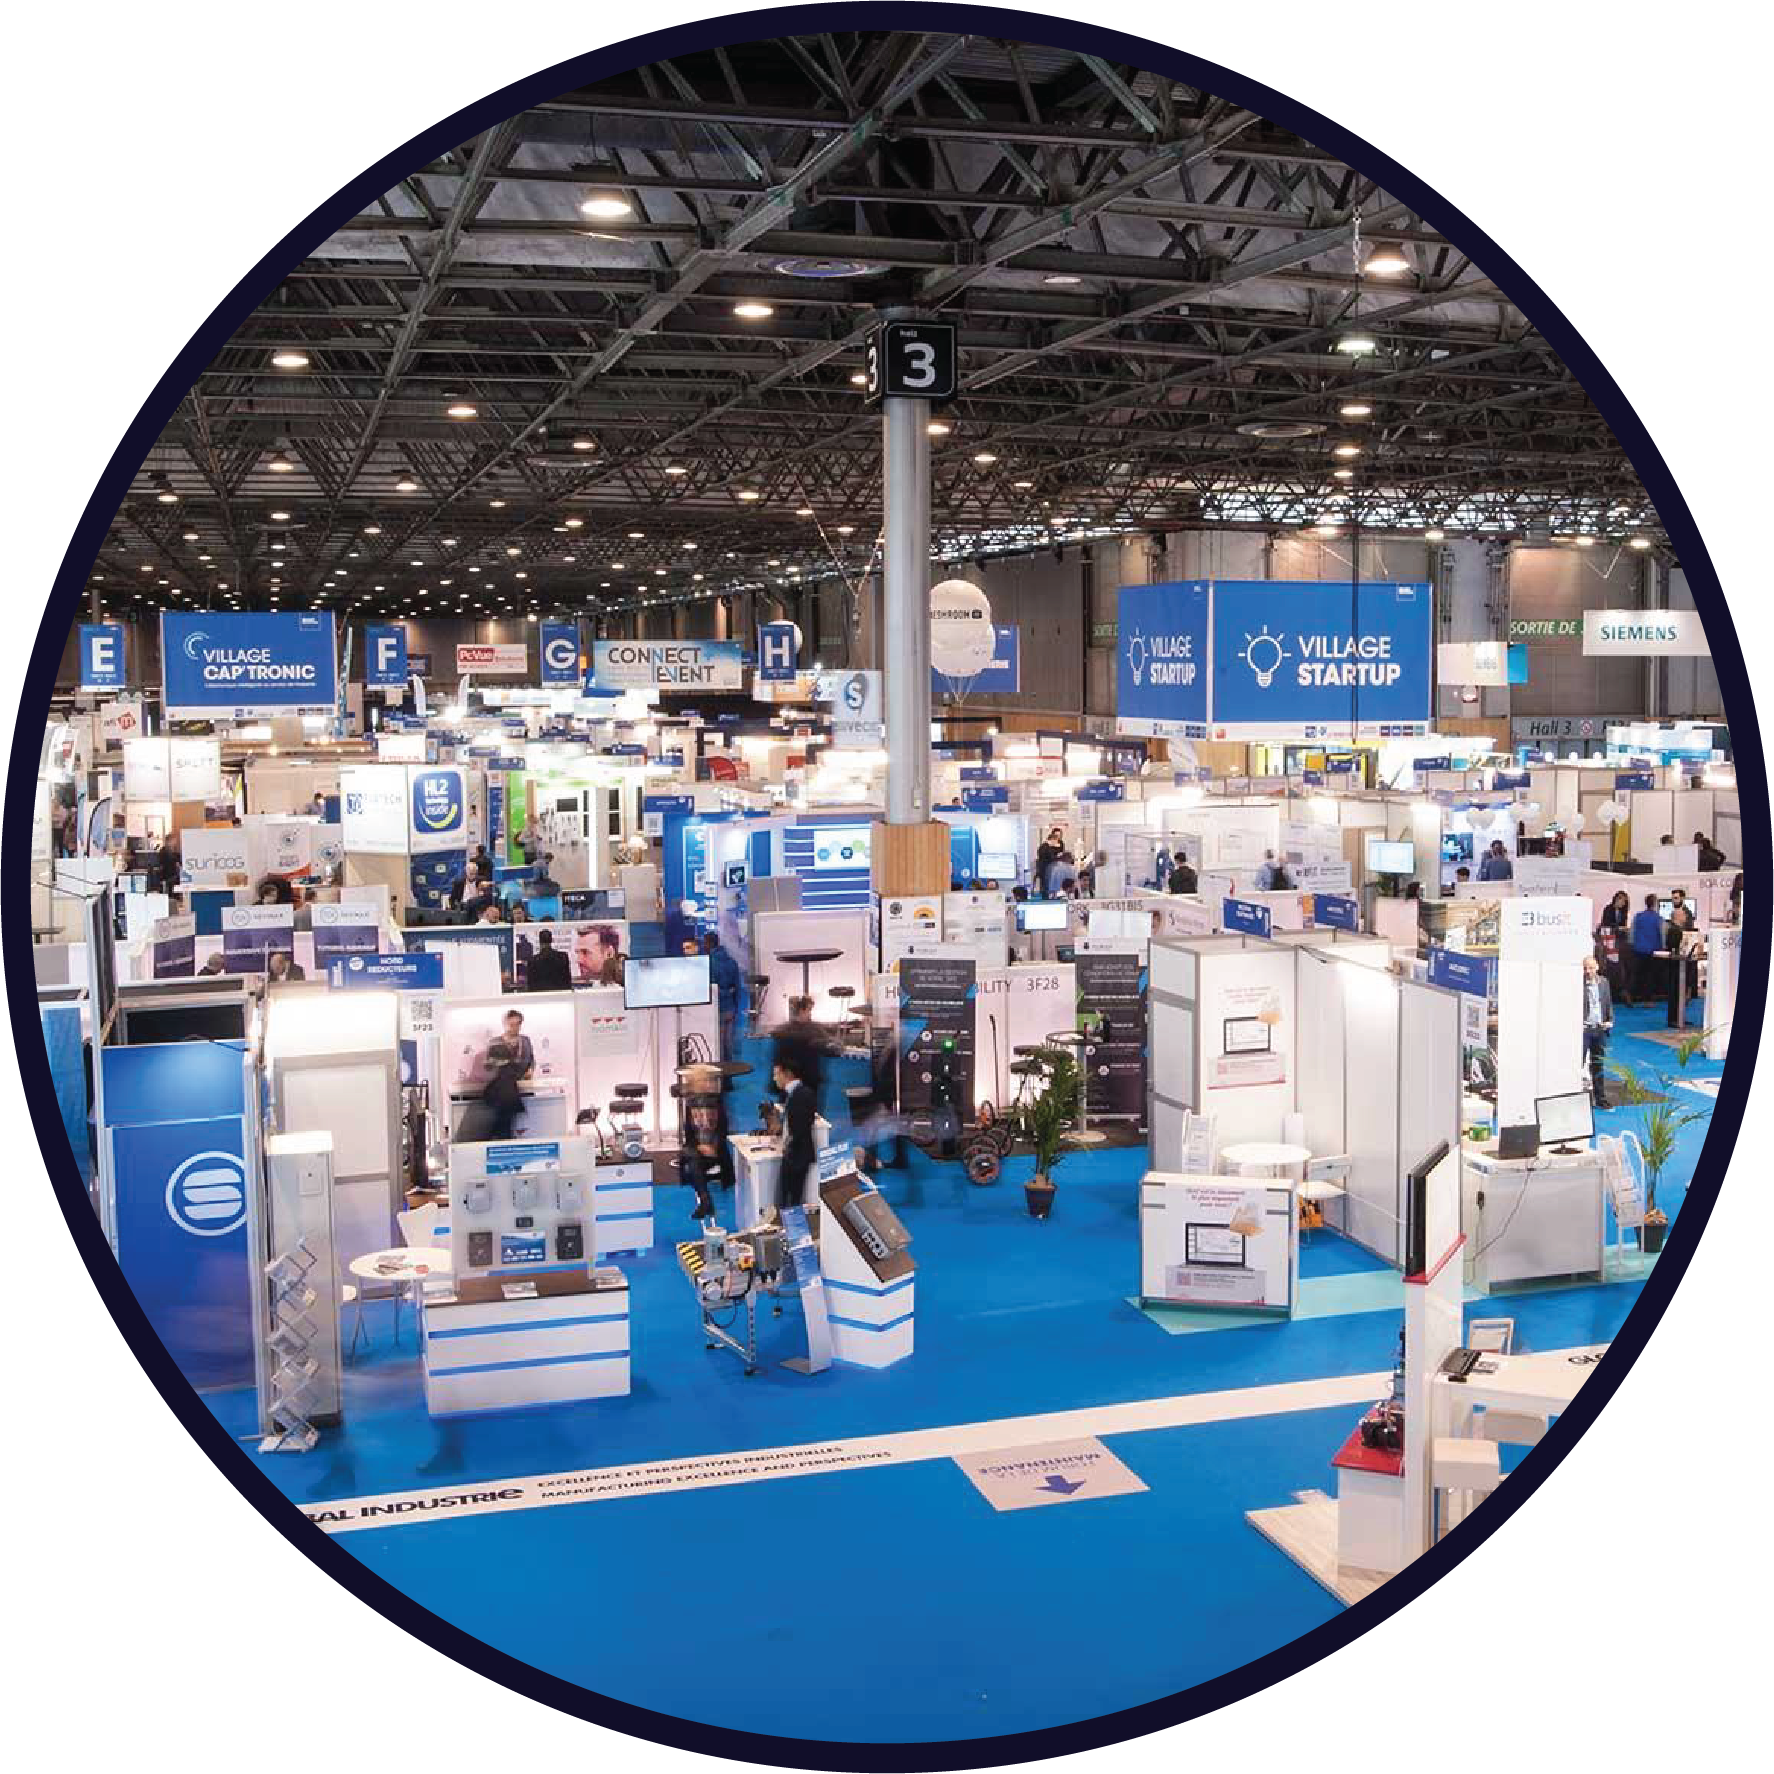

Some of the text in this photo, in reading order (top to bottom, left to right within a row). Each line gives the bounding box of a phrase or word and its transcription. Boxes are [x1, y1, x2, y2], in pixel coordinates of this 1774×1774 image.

[868, 346, 879, 391] 3
[903, 343, 935, 387] 3
[930, 610, 970, 620] ESHROOM
[1510, 621, 1579, 635] SORTIE DE
[1600, 626, 1678, 641] SIEMENS
[91, 637, 114, 672] E
[203, 649, 271, 663] VILLAGE
[377, 637, 397, 671] F
[545, 638, 576, 669] G
[608, 647, 702, 663] CONNECT
[764, 635, 790, 668] H
[1150, 635, 1192, 657] VILLAGE
[1298, 635, 1391, 658] VILLAGE
[656, 665, 715, 683] EVENT
[1150, 662, 1196, 685] STARTUP
[1298, 662, 1401, 686] STARTUP
[1530, 720, 1571, 735] Hall 3
[976, 977, 1060, 994] ILITY 3F28
